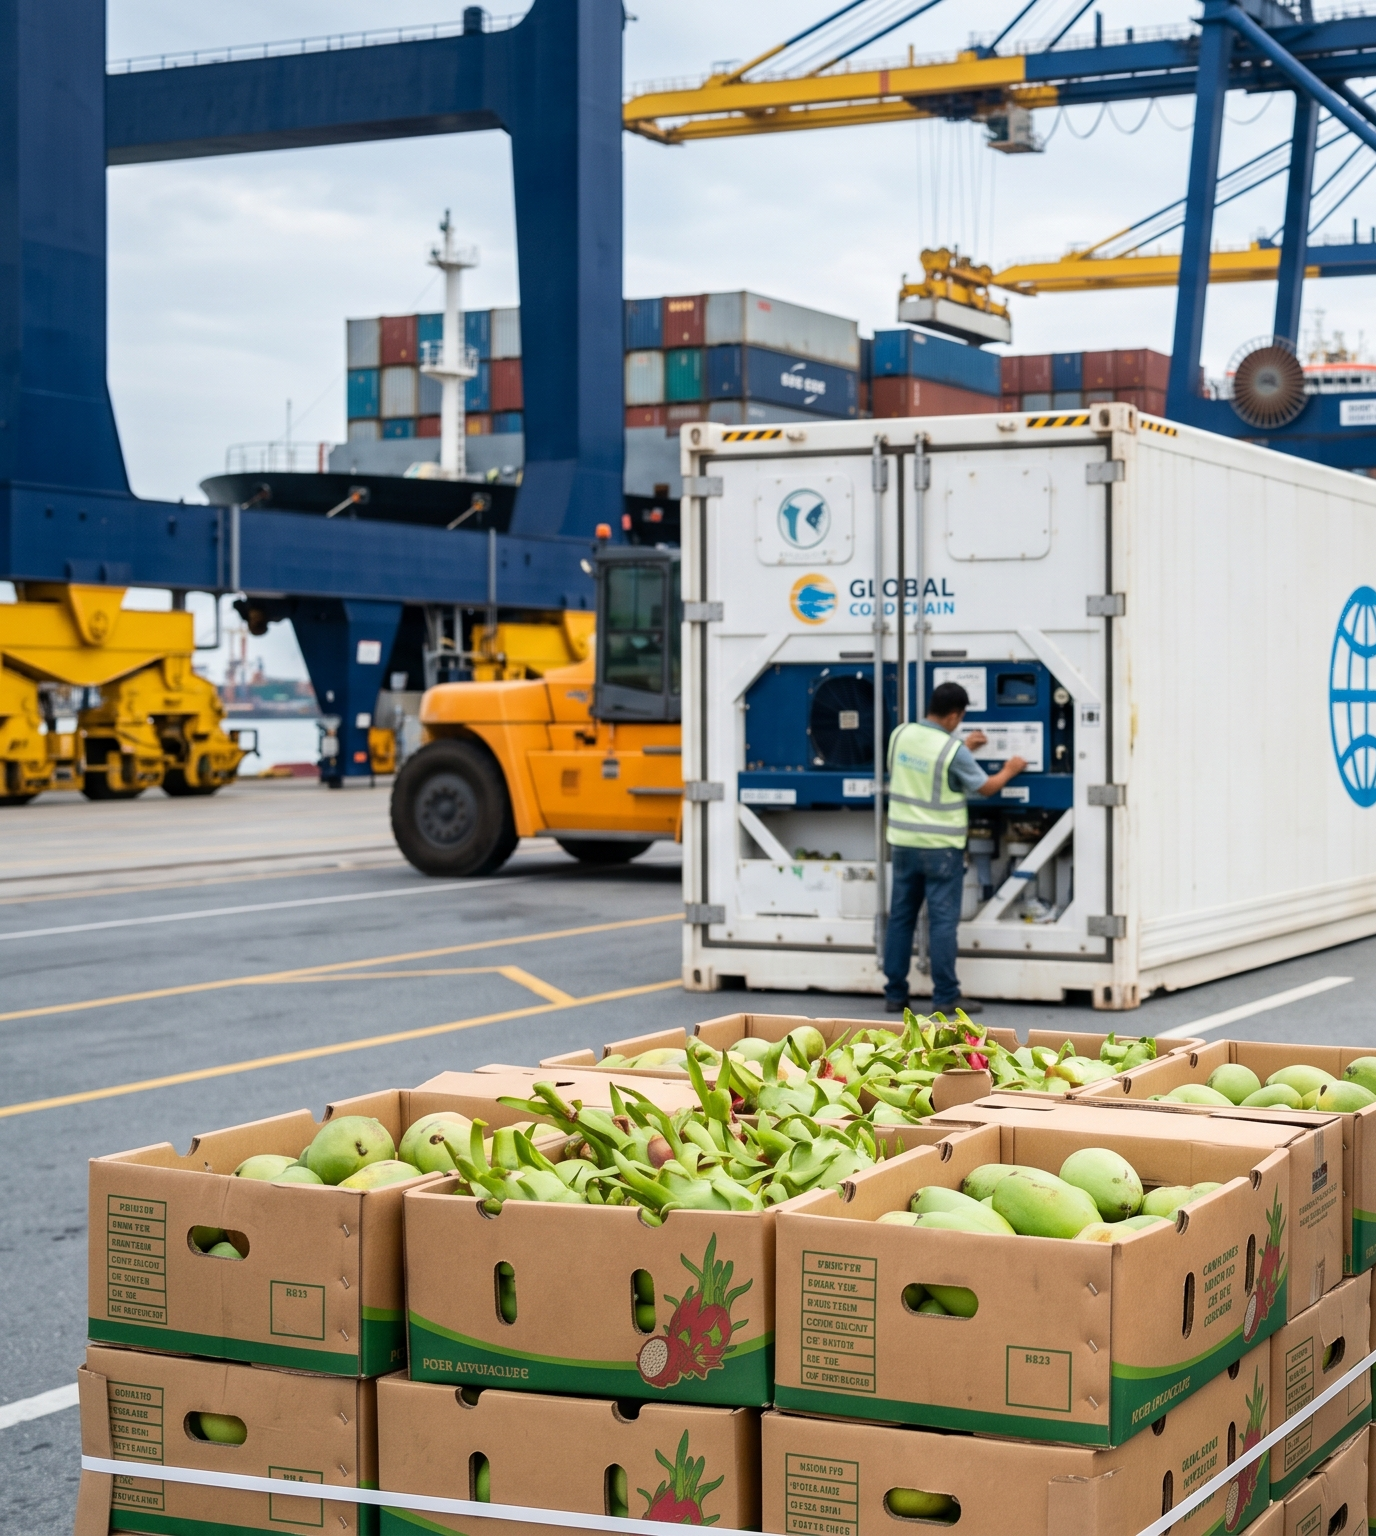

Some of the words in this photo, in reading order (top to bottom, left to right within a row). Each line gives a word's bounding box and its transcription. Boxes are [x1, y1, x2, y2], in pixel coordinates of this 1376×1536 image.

[849, 578, 955, 598] GLOBAL
[849, 602, 895, 617] COD
[422, 1357, 453, 1371] POER
